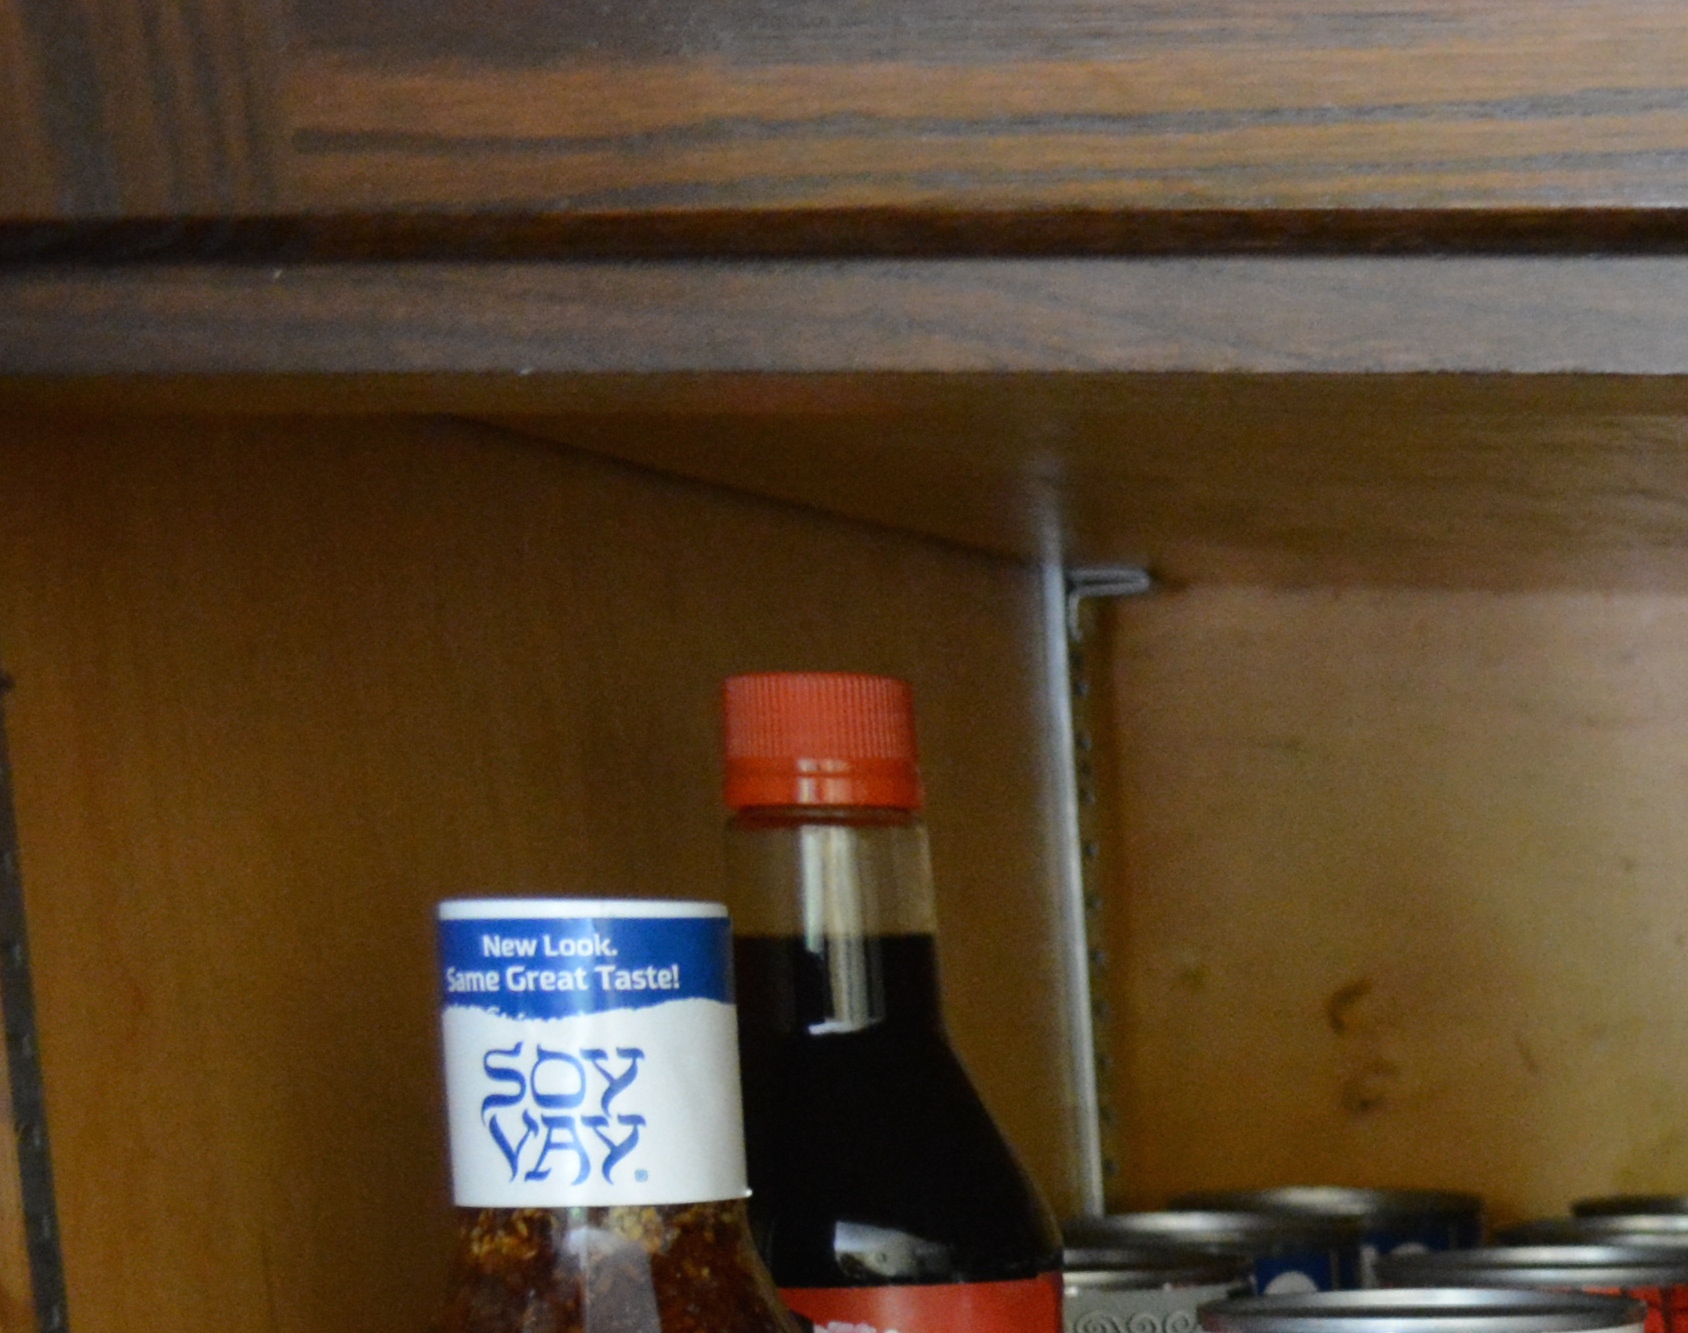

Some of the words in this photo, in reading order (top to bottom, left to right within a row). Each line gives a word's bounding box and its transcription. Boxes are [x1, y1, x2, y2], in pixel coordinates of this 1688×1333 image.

[482, 934, 538, 957] New
[543, 933, 618, 957] Look.
[446, 966, 500, 992] Same
[506, 966, 589, 992] Great
[594, 964, 681, 990] Taste!
[481, 1041, 646, 1120] SOY
[487, 1112, 647, 1186] VAY
